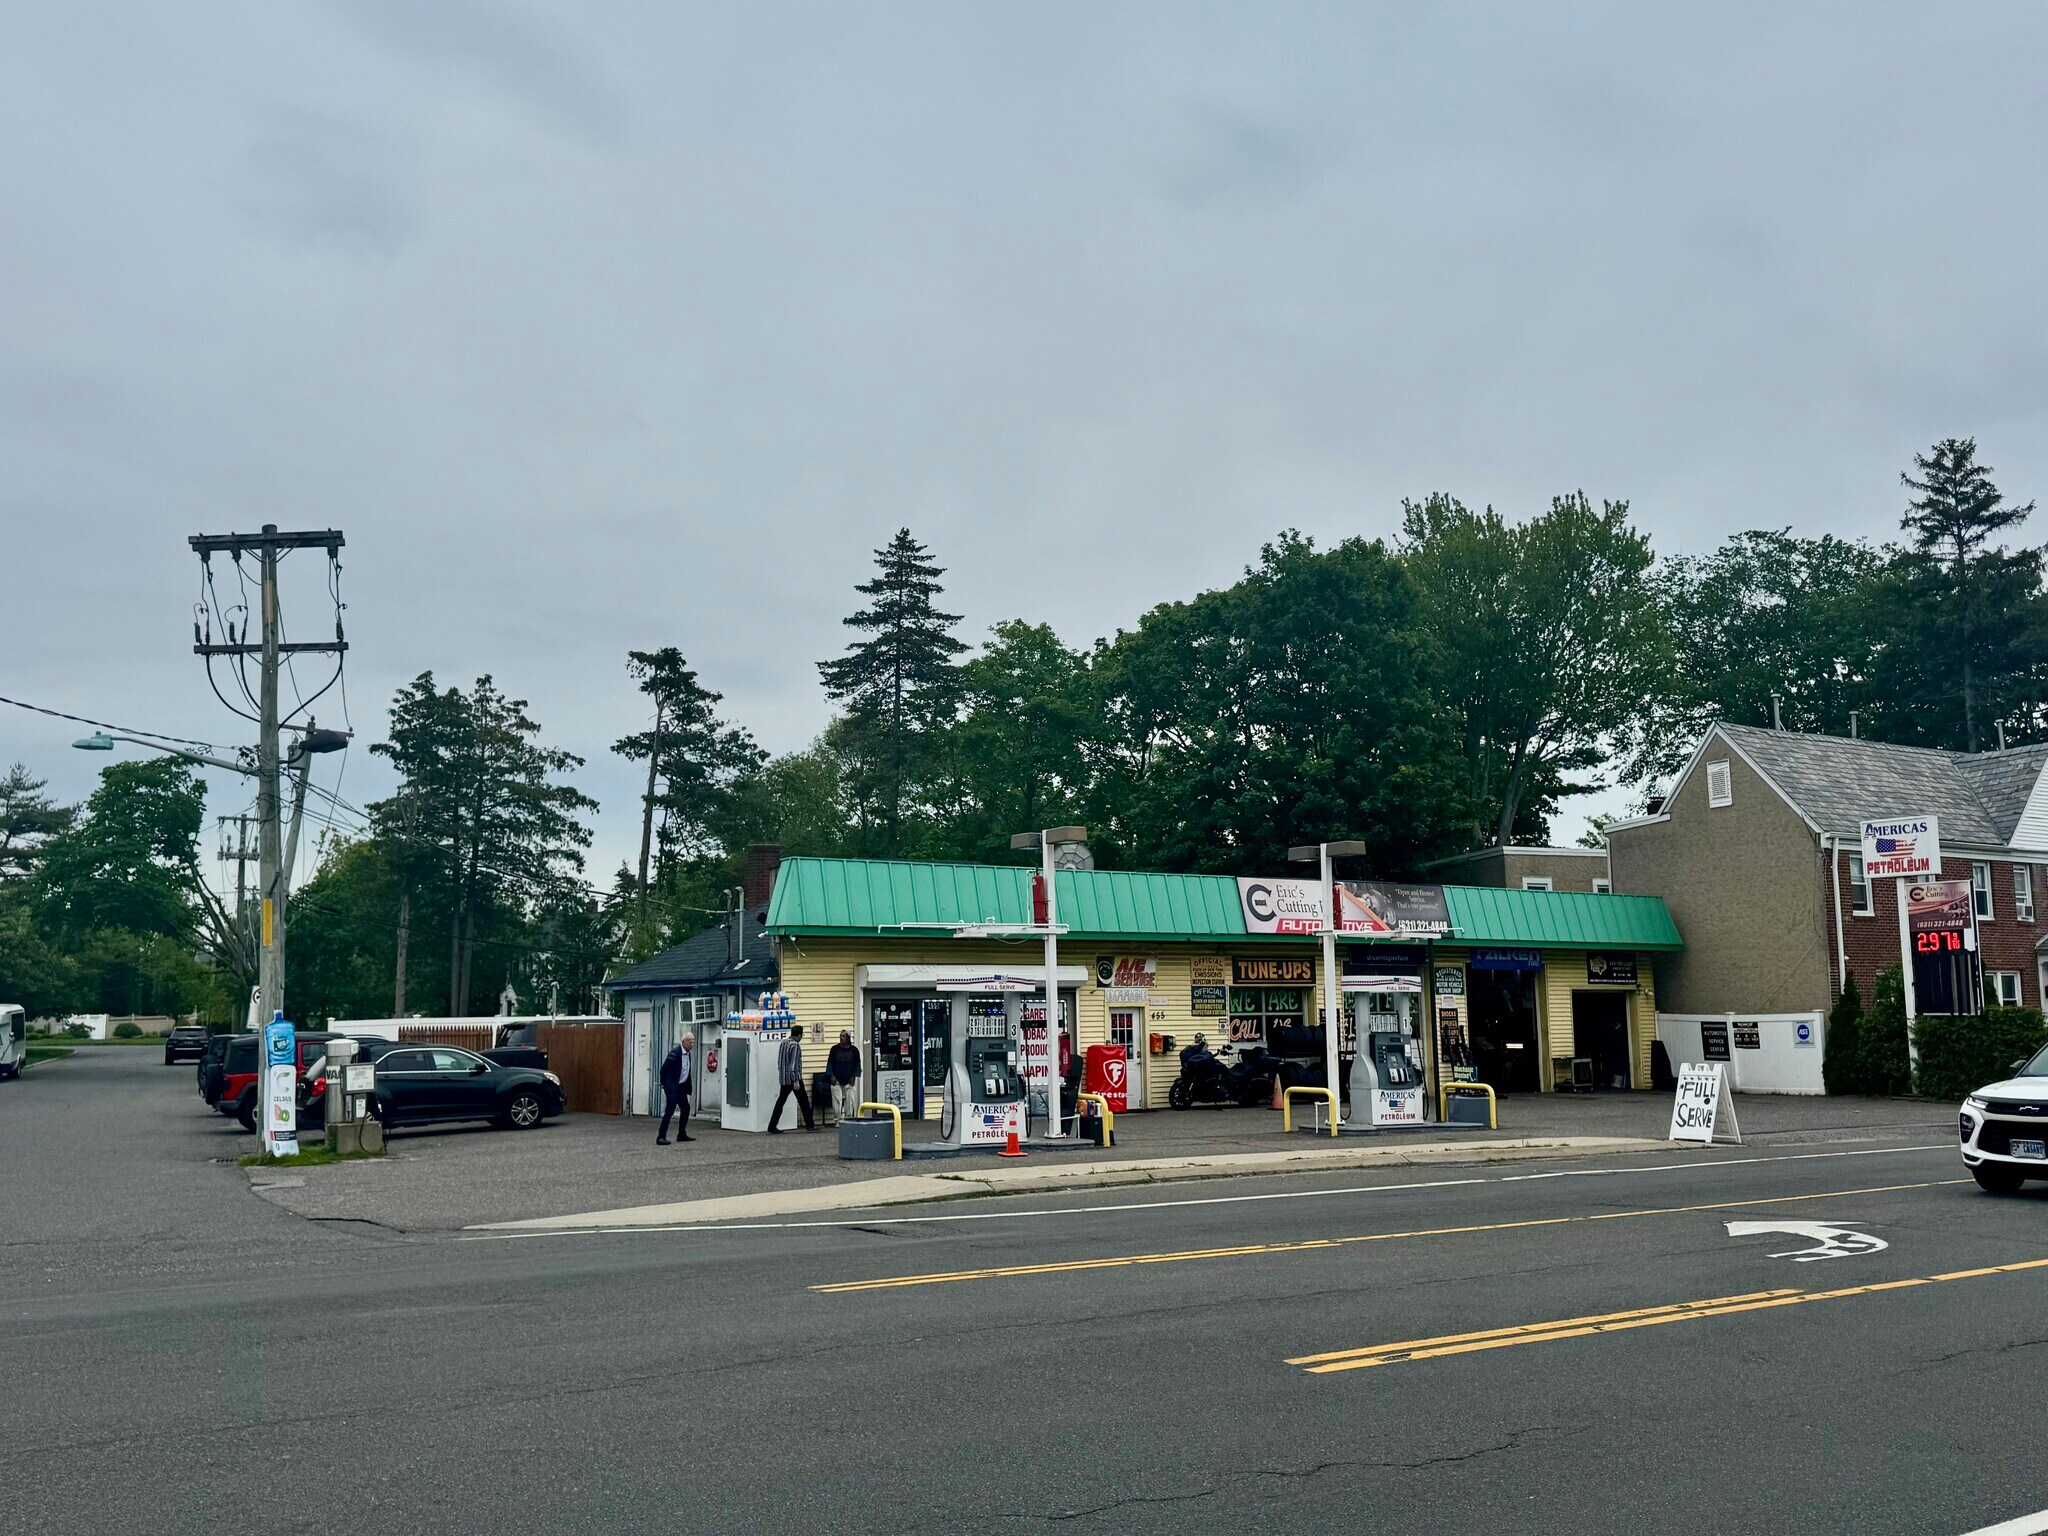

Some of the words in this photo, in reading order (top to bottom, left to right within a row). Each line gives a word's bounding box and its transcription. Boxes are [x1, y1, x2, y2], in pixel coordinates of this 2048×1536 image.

[1864, 822, 1928, 839] AMERICAS
[1866, 858, 1930, 875] PETROLEUM
[1276, 884, 1305, 898] Eric's
[1276, 899, 1319, 918] Cutting
[1116, 958, 1147, 973] A/C
[1193, 957, 1223, 967] OFFICIAL
[1238, 961, 1311, 979] TUNE-UPS
[1113, 972, 1156, 987] SERVICE
[1106, 989, 1149, 1002] OFFICE
[1193, 987, 1224, 998] OFFICIAL
[1230, 991, 1256, 1013] WE
[1267, 990, 1299, 1011] ARE
[1440, 1010, 1457, 1018] SHOCKS
[766, 1032, 788, 1041] ICE
[1011, 1024, 1017, 1036] 3
[1229, 1019, 1261, 1041] CALL
[927, 1037, 943, 1049] ATM
[1379, 1091, 1416, 1103] AMERICAS
[1681, 1081, 1716, 1100] FULL
[1380, 1113, 1416, 1121] PETROLEUM
[1675, 1102, 1713, 1128] SERVE
